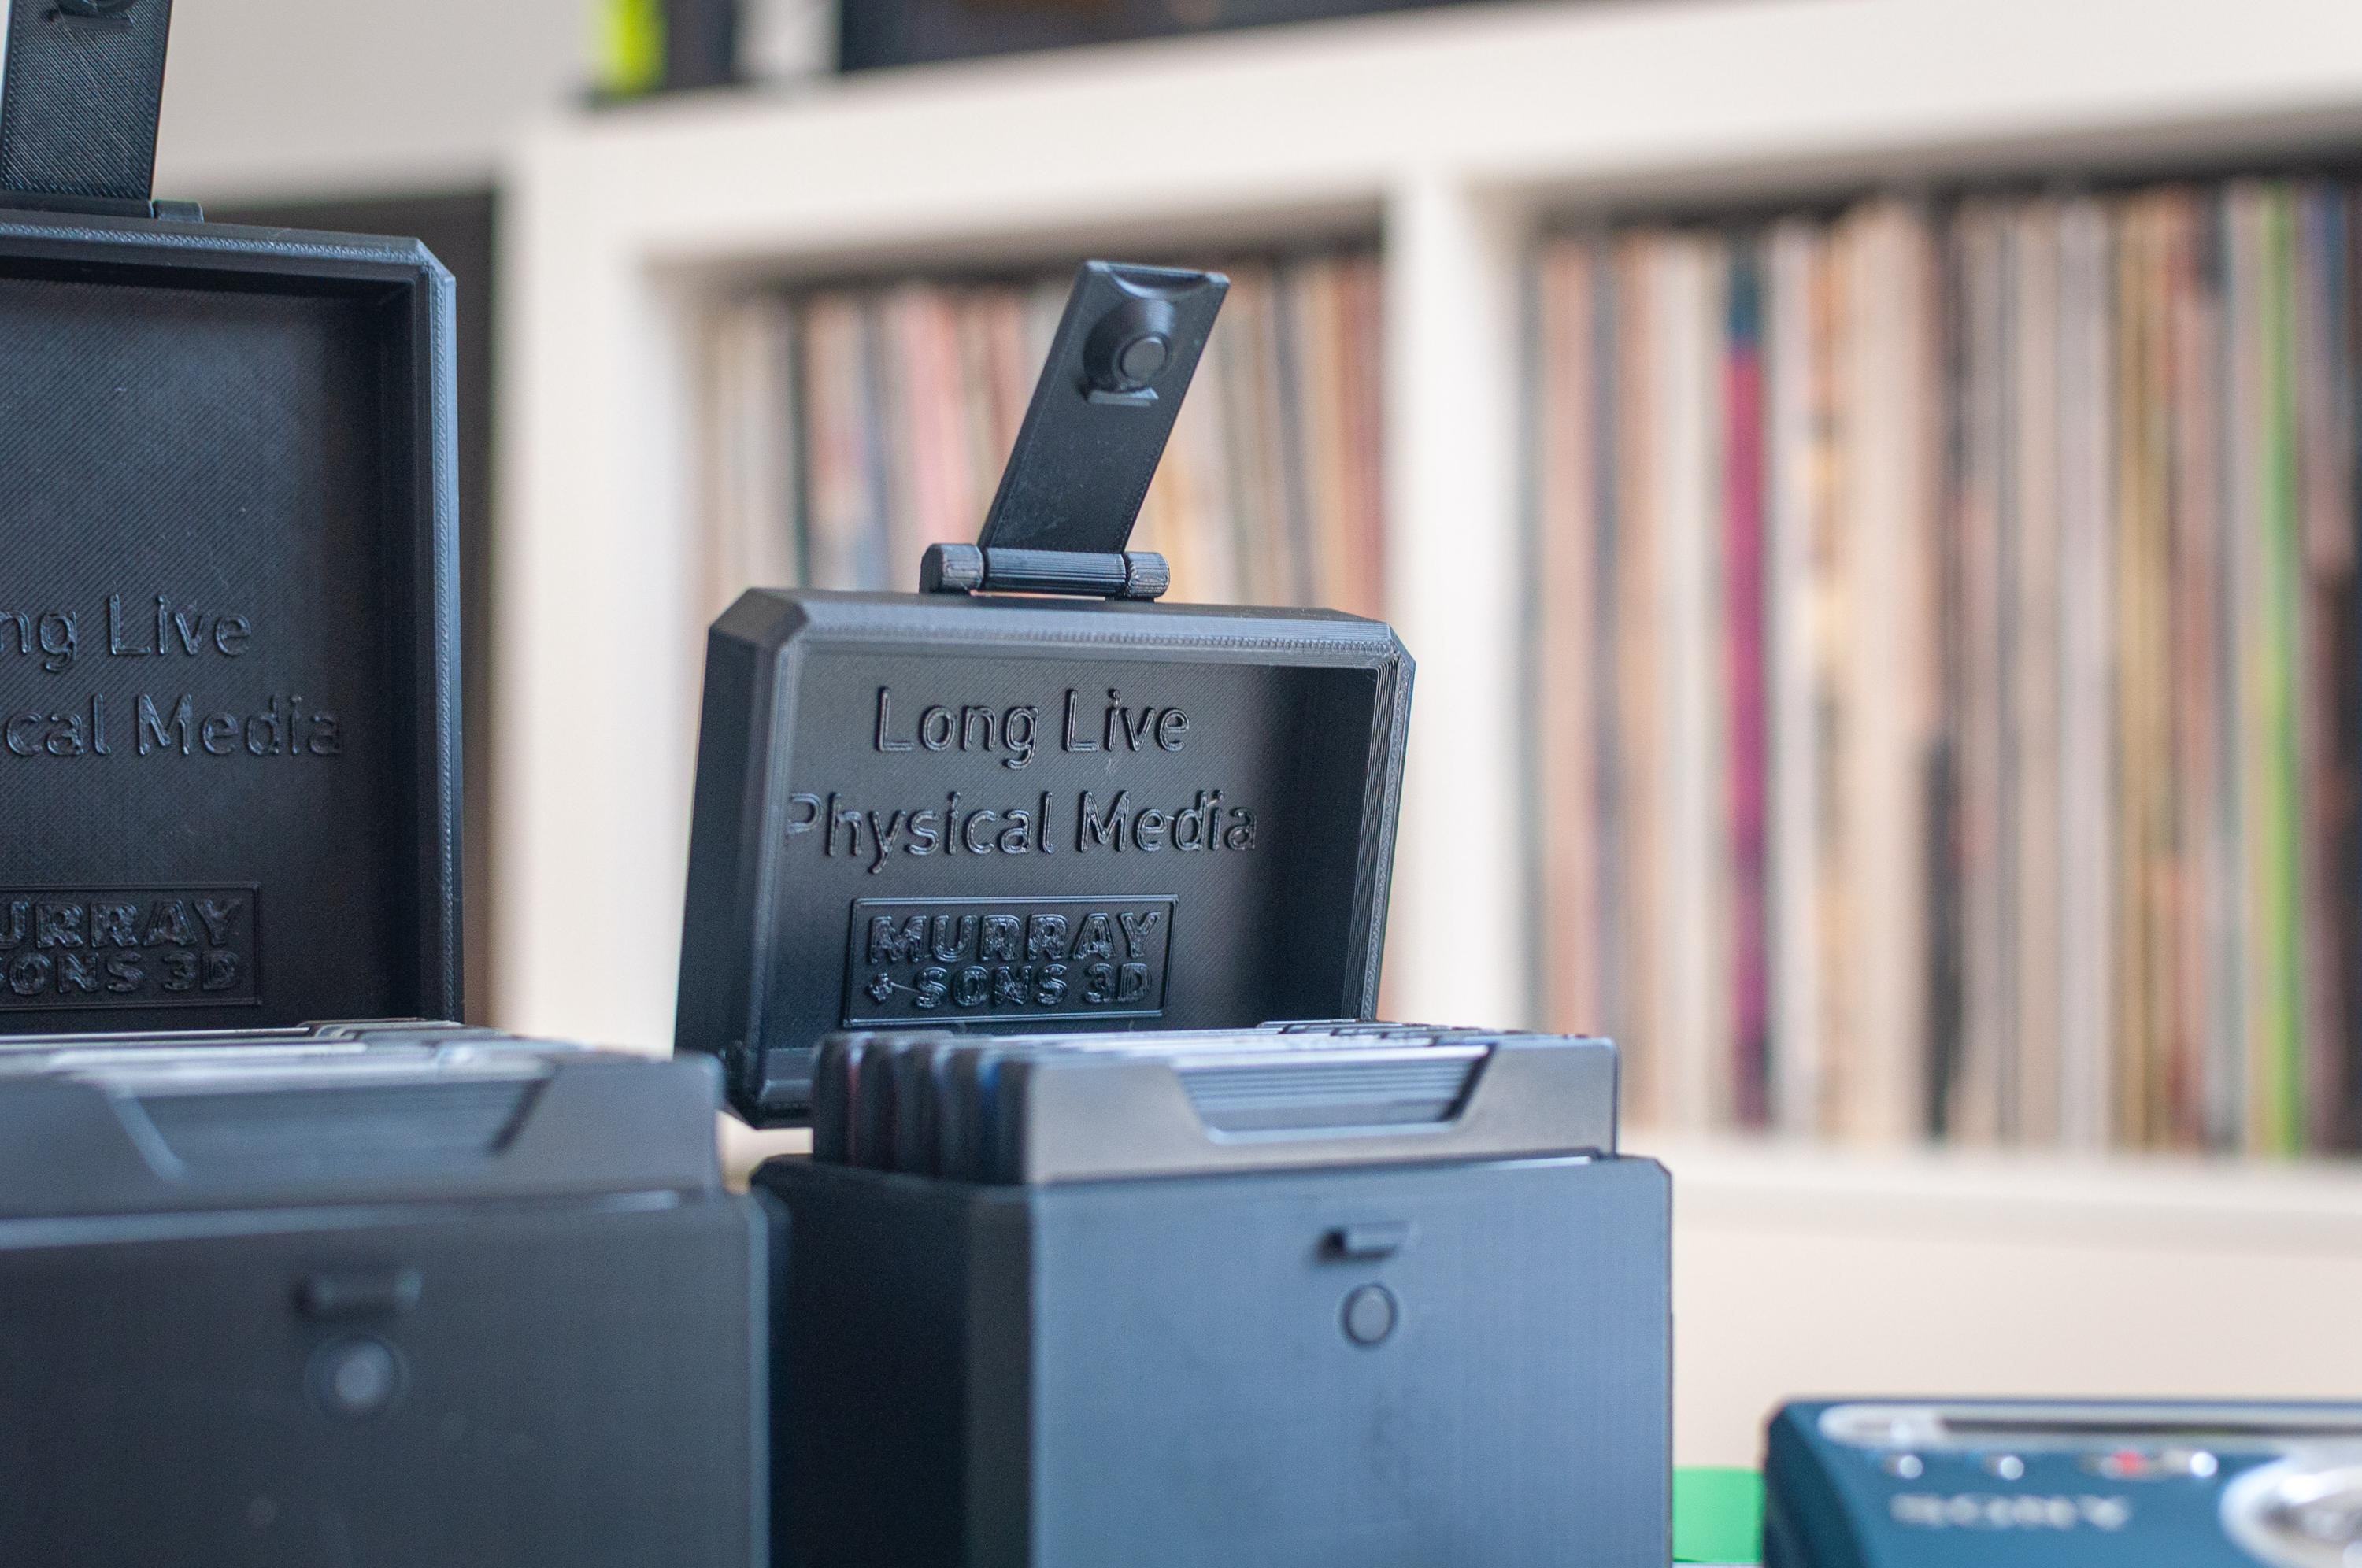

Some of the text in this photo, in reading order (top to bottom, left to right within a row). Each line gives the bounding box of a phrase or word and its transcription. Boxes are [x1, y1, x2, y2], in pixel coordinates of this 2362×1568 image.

[109, 594, 252, 656] Live
[138, 693, 341, 756] Media
[876, 686, 1190, 769] Long Live
[786, 790, 1257, 874] Physical Media
[869, 912, 1161, 965] MURRAY
[0, 950, 241, 996] ONS 3D
[913, 964, 1068, 1008] SONS
[1083, 962, 1153, 1004] 3D
